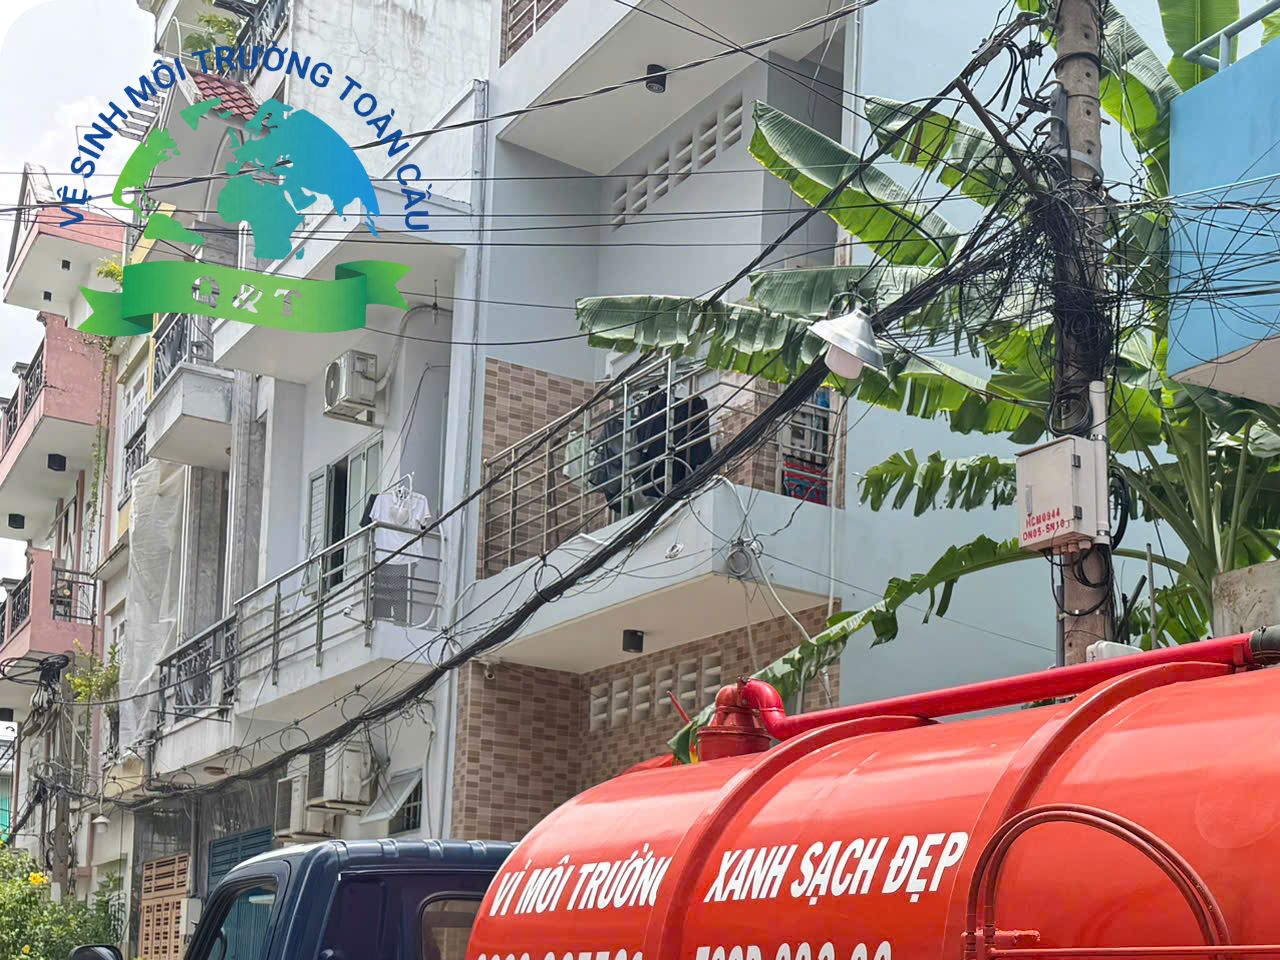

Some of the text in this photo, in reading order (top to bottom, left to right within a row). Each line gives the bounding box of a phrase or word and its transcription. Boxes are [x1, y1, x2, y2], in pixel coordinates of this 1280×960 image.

[514, 855, 575, 914] MÔI
[704, 831, 969, 906] XANH SẠCH ĐẸP
